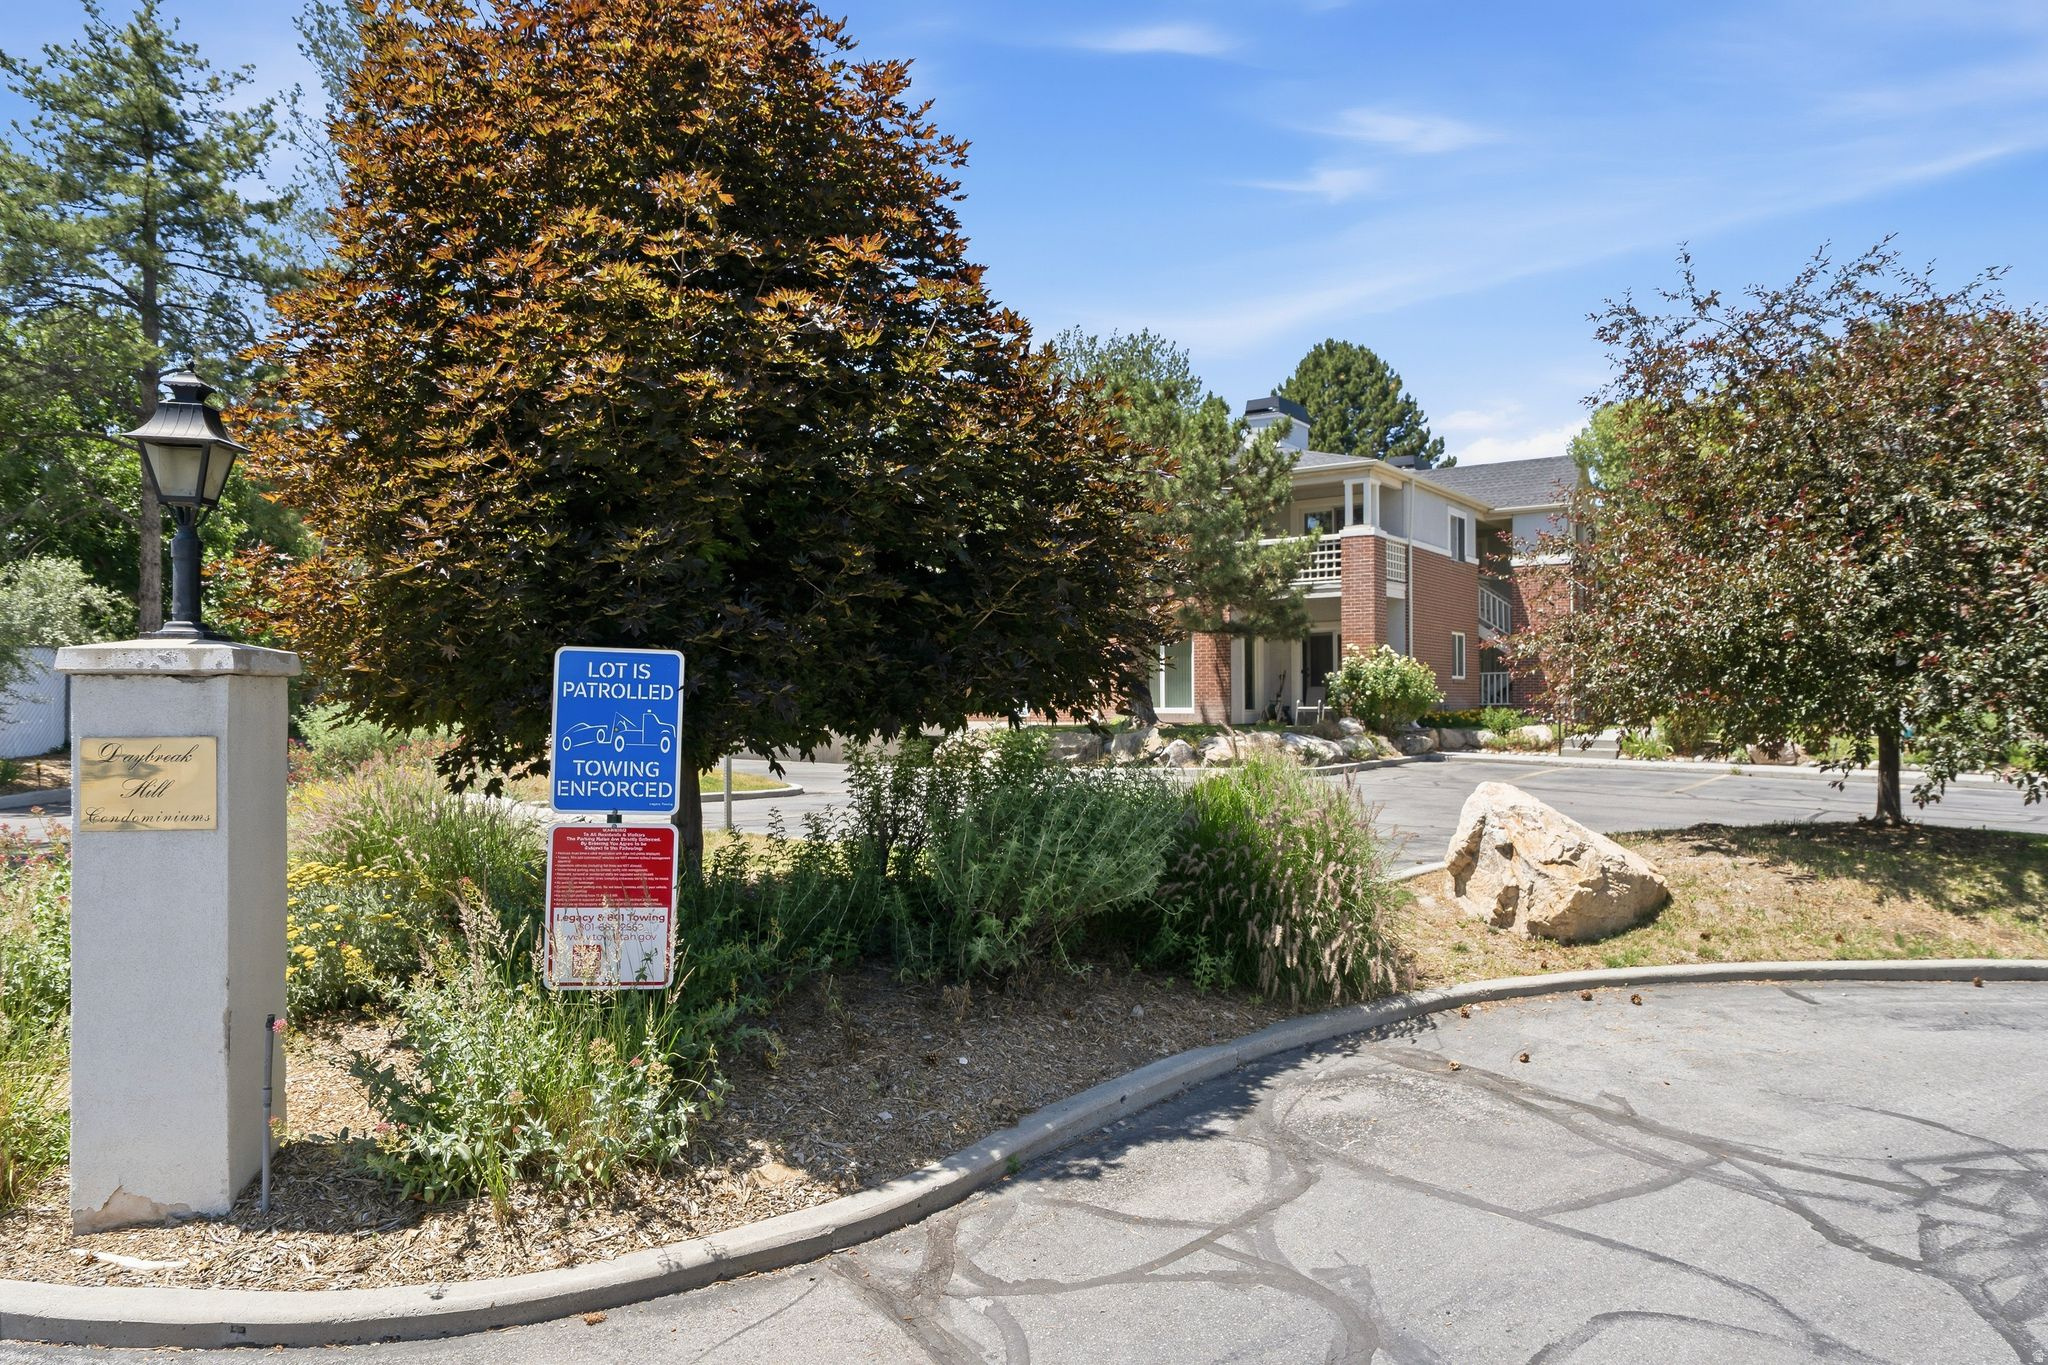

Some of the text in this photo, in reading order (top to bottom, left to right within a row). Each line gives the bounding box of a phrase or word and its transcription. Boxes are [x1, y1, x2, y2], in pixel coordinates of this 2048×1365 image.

[588, 661, 651, 680] LOT IS
[563, 681, 674, 701] PATROLLED
[97, 742, 200, 771] Daybreak
[573, 759, 660, 778] TOWING
[119, 778, 176, 799] Hill
[557, 780, 673, 799] ENFORCED
[85, 806, 211, 824] Condominiums
[556, 913, 595, 924] Legacy
[597, 914, 604, 922] &
[627, 914, 665, 923] Towing
